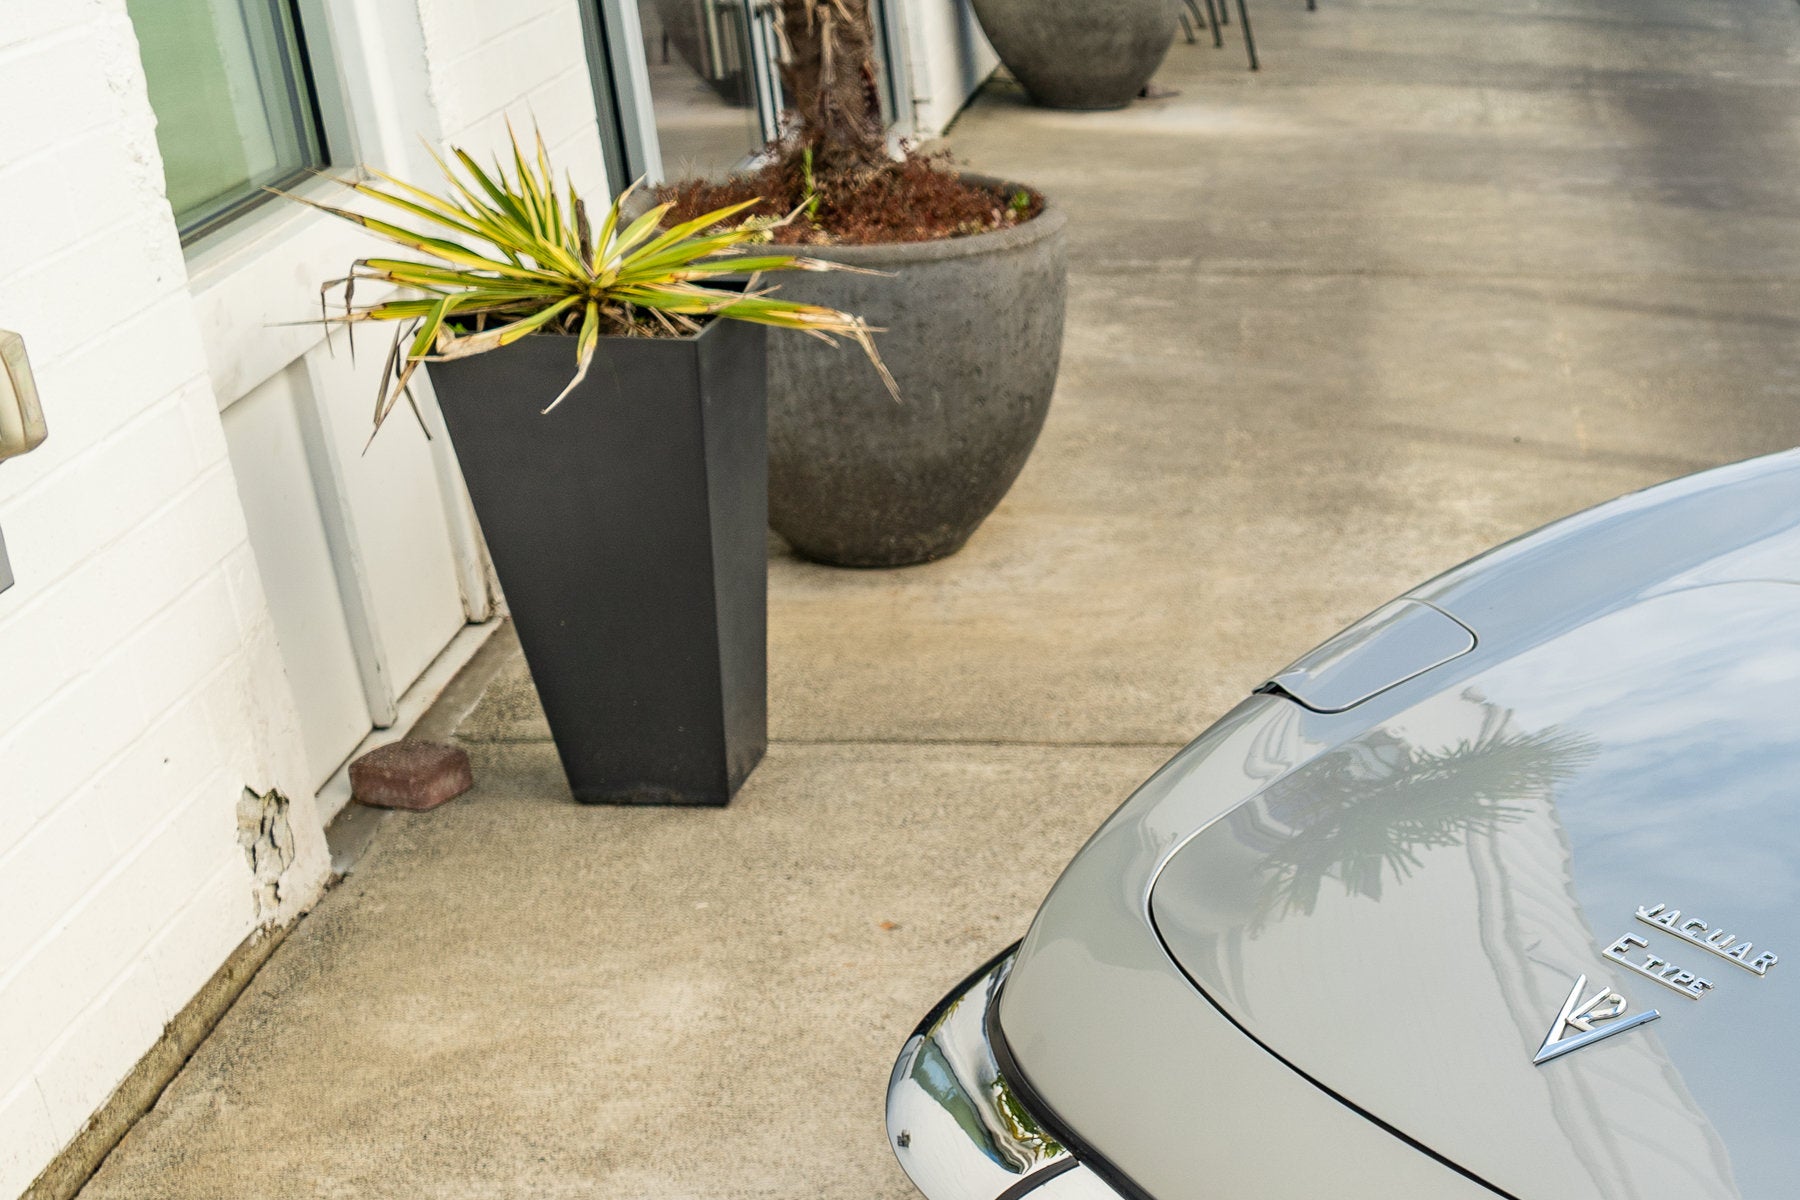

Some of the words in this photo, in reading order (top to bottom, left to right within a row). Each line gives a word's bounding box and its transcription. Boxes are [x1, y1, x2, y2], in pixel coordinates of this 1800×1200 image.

[1602, 931, 1649, 960] E
[1645, 953, 1714, 997] TYPE
[1635, 903, 1778, 975] JAGUAR
